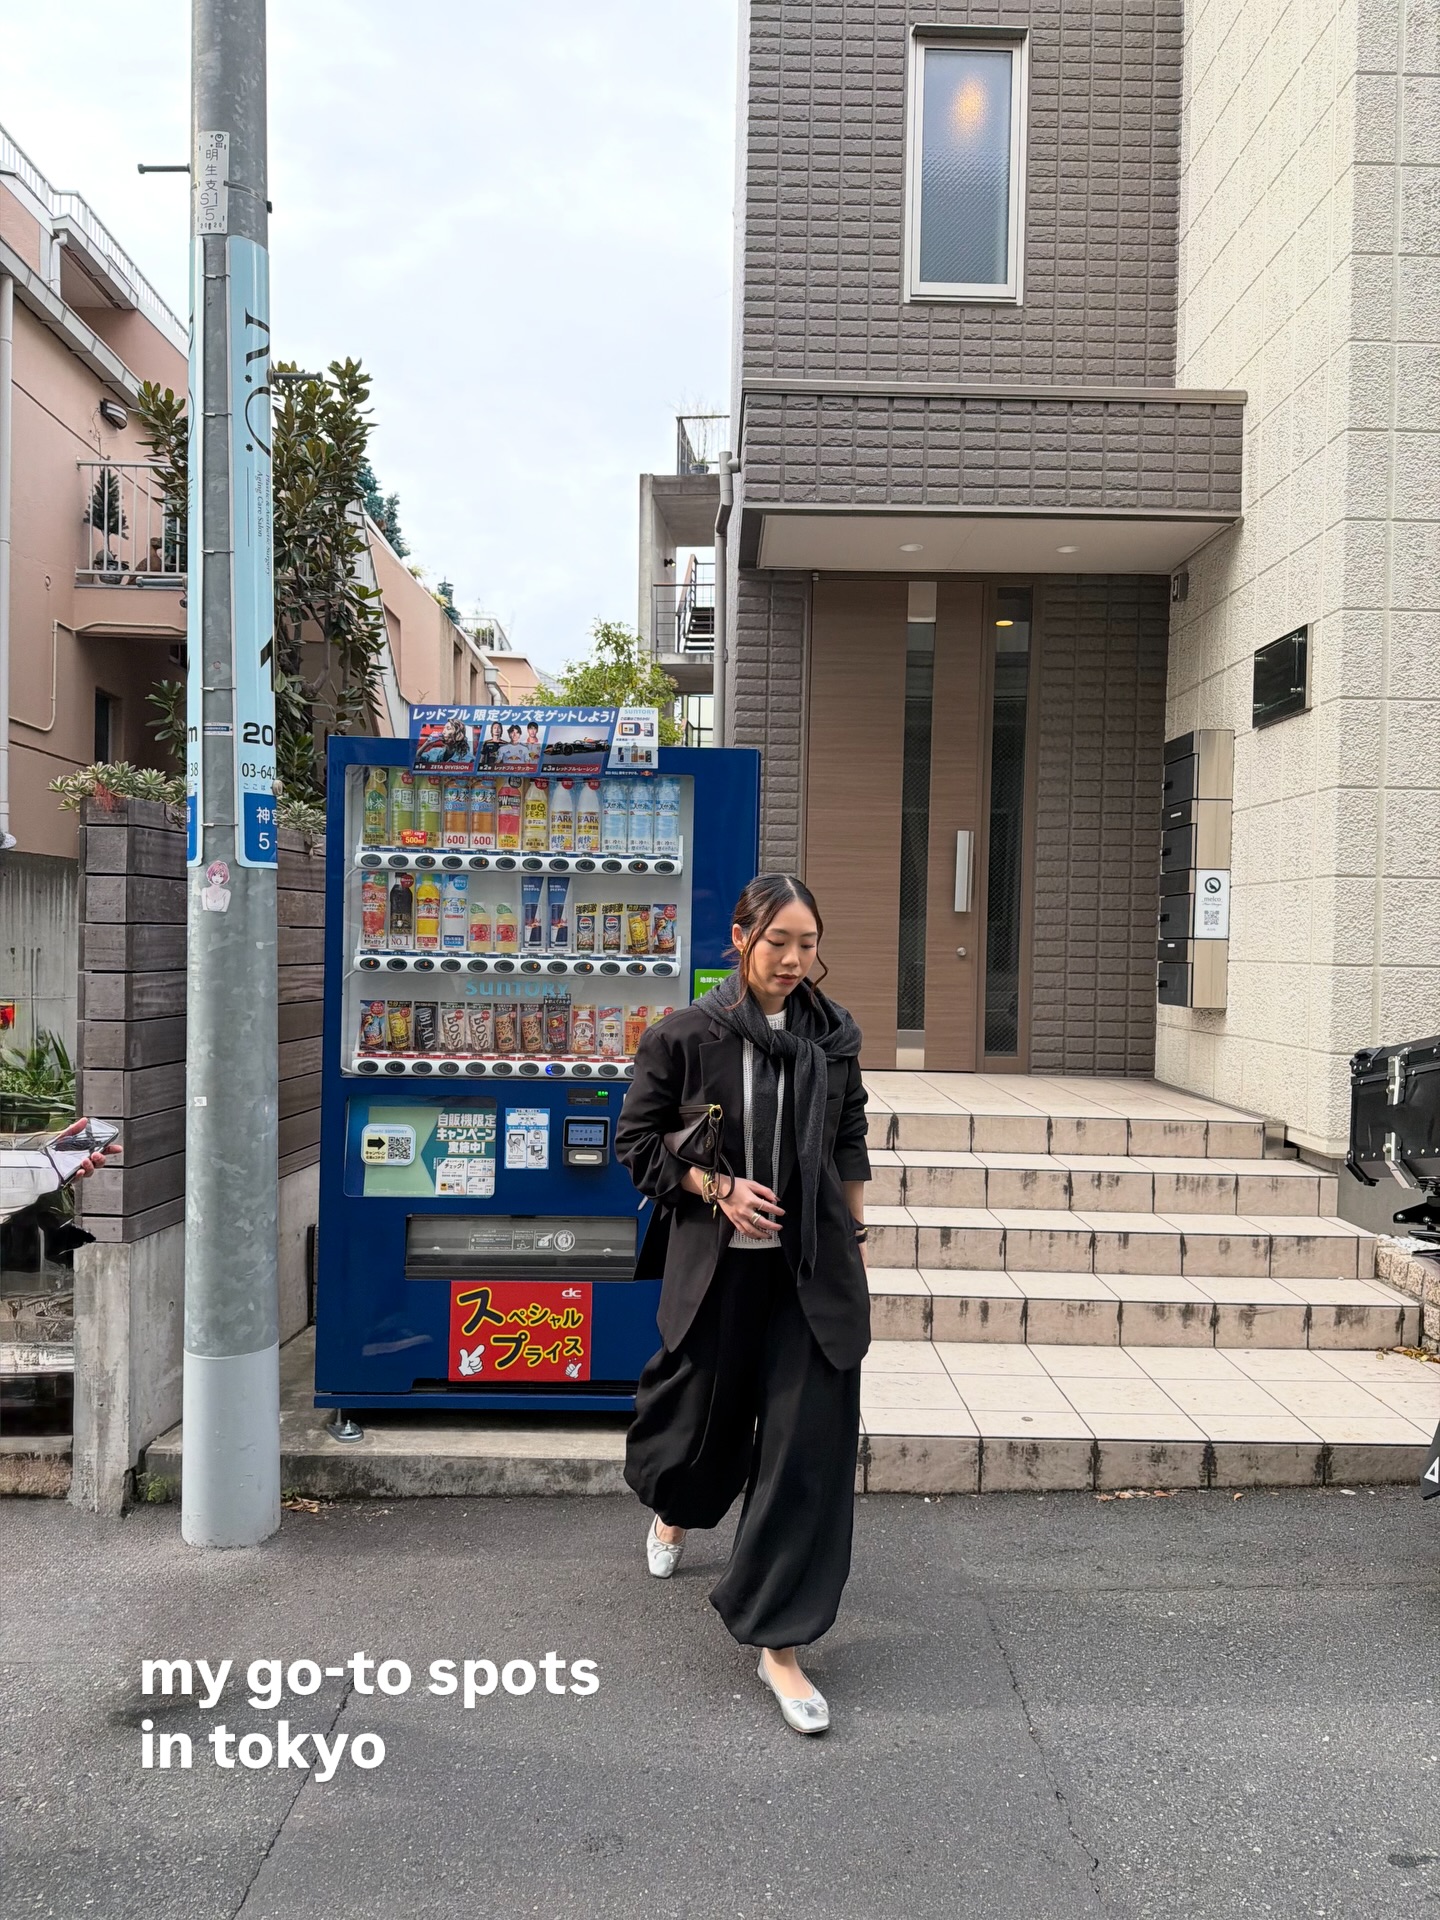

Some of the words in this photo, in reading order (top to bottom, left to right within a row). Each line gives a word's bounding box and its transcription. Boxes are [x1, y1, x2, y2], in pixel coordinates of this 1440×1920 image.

[205, 148, 218, 191] 明生支
[254, 470, 263, 494] Aging
[256, 495, 264, 516] Care
[413, 708, 470, 721] レッドブル
[473, 709, 615, 723] 限定グッズをゲットしよう!
[405, 836, 425, 844] 500ml
[447, 835, 464, 844] 600
[474, 836, 491, 845] 600
[575, 903, 597, 914] 強刺激
[602, 903, 623, 914] 強刺激
[419, 1007, 435, 1049] BLACK
[447, 1016, 463, 1047] BOSS
[473, 1017, 488, 1048] BOSS
[437, 1113, 497, 1127] 自販機限定
[436, 1128, 496, 1140] キャンペーン
[447, 1141, 486, 1154] 実施中!
[561, 1287, 582, 1298] dc
[456, 1286, 584, 1335] スペシャル
[490, 1331, 584, 1370] プライス
